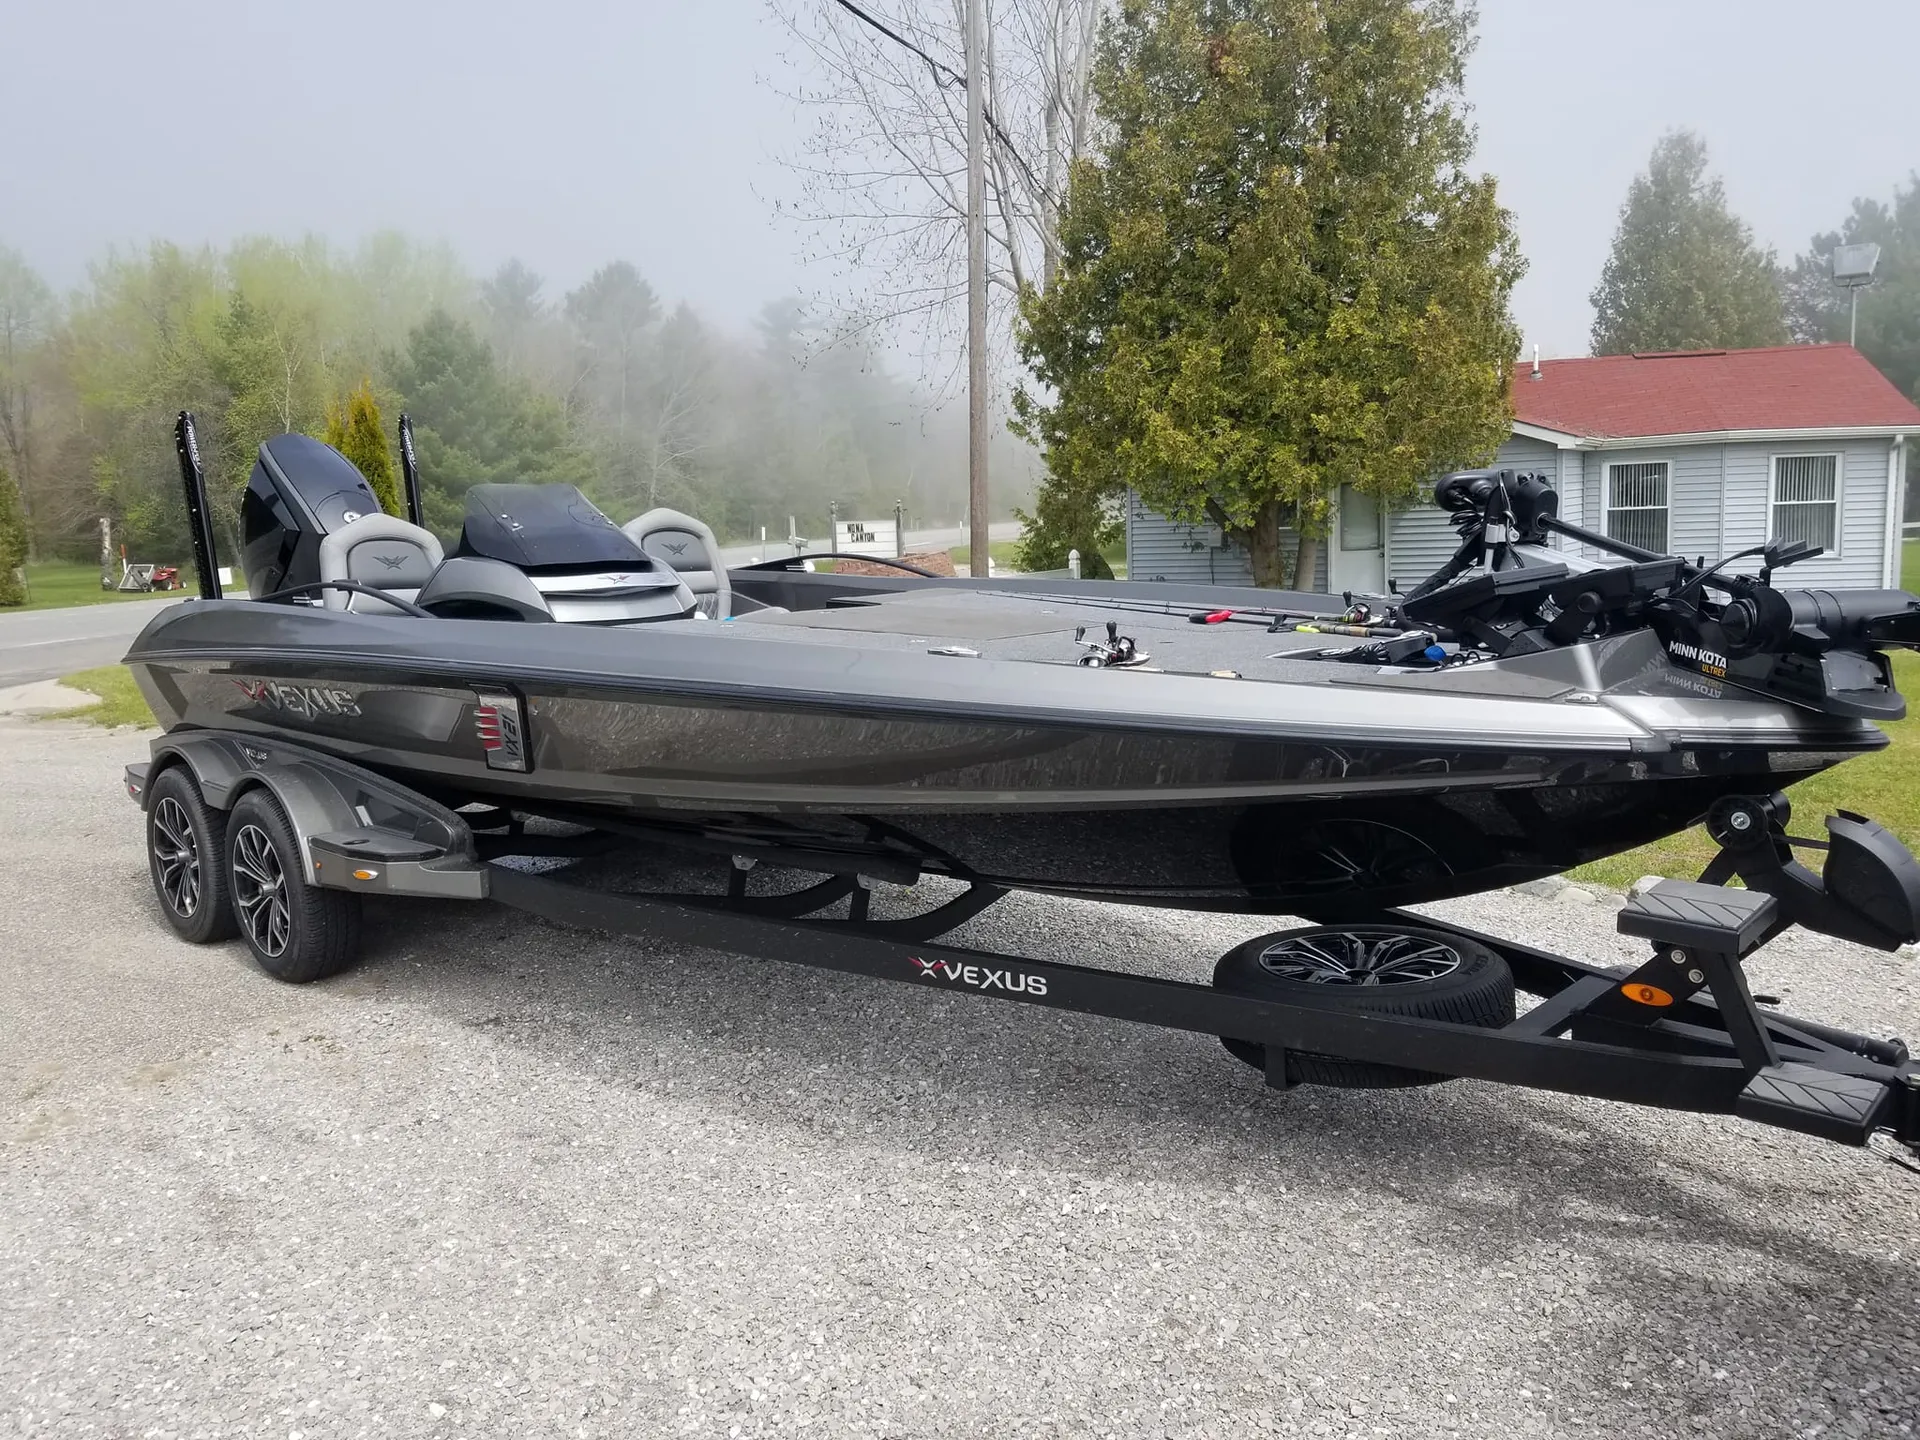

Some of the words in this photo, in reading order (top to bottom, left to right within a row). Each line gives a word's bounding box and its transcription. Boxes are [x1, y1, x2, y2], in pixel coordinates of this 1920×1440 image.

[851, 532, 875, 542] CANYON
[1669, 640, 1698, 660] MINN
[1698, 648, 1727, 669] KOTA
[1702, 663, 1727, 678] ULTREX
[256, 680, 362, 721] VEXUS
[940, 959, 1048, 996] VEXUS
